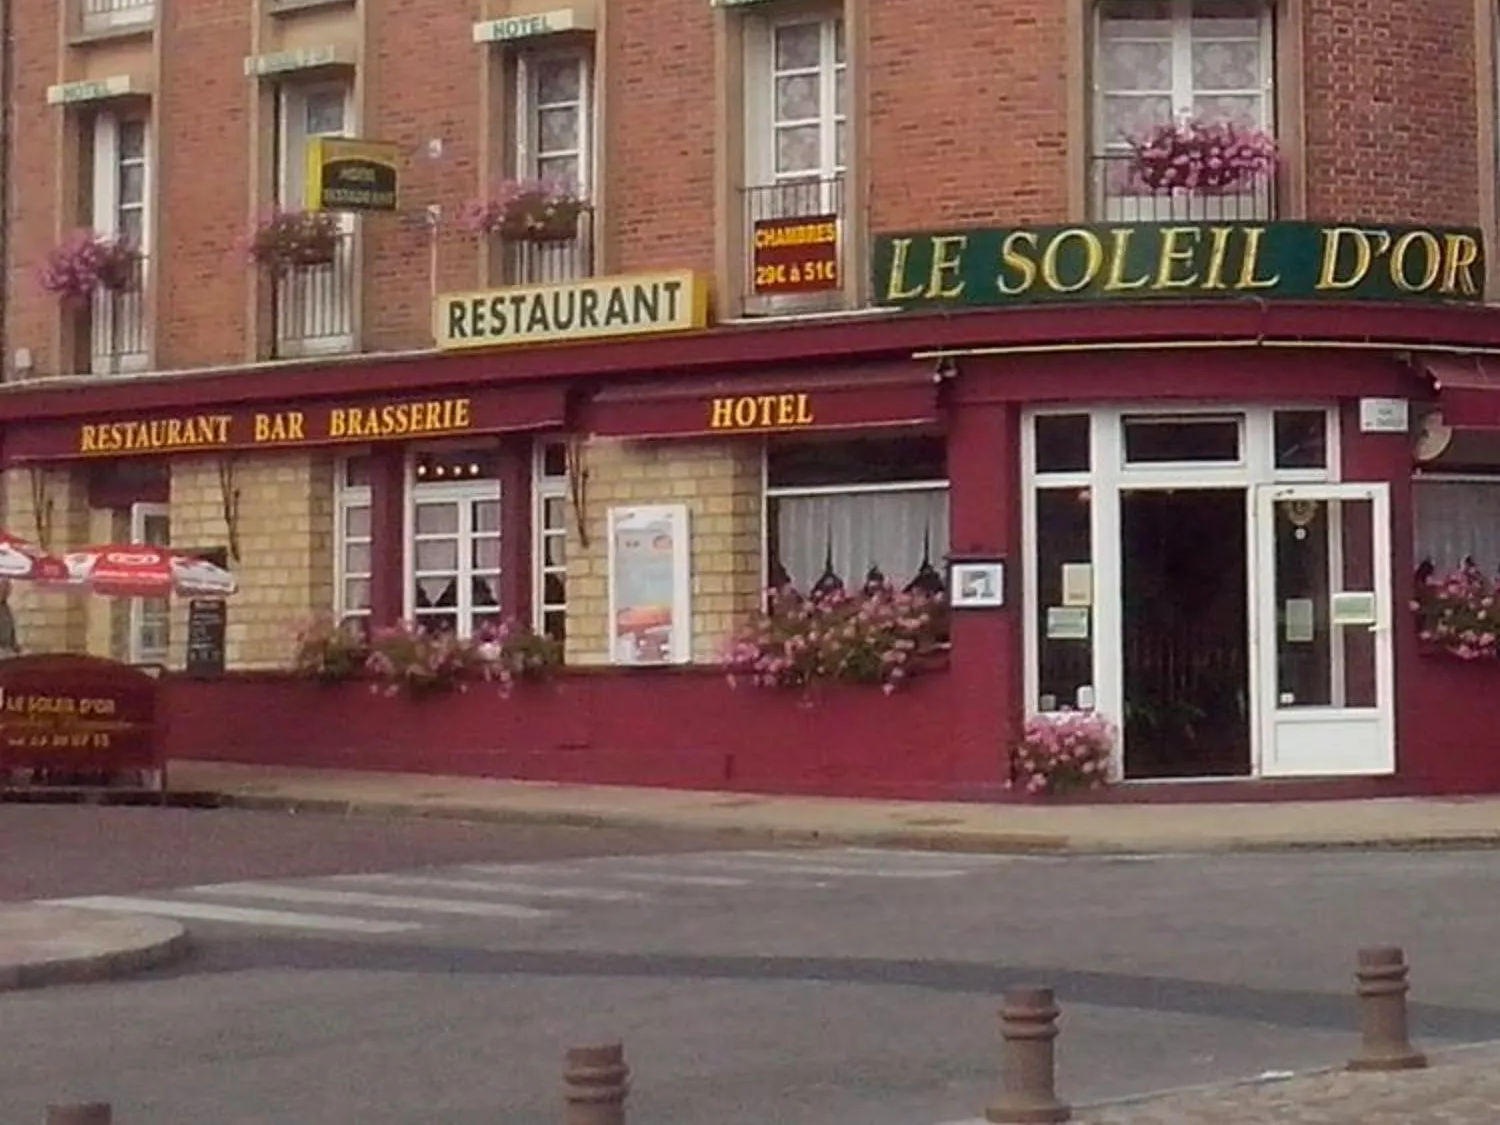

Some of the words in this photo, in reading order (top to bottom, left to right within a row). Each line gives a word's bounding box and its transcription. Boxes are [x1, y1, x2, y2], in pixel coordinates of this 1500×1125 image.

[492, 15, 553, 38] HOTEL
[755, 222, 834, 248] CHAMBRES
[887, 236, 967, 300] LE
[997, 226, 1280, 295] SOLEIL
[1315, 226, 1480, 296] D'OR
[448, 281, 682, 340] RESTAURANT
[80, 415, 232, 452] RESTAURANT
[254, 411, 304, 442] BAR
[329, 399, 470, 437] BRASSERIE
[710, 393, 814, 428] HOTEL
